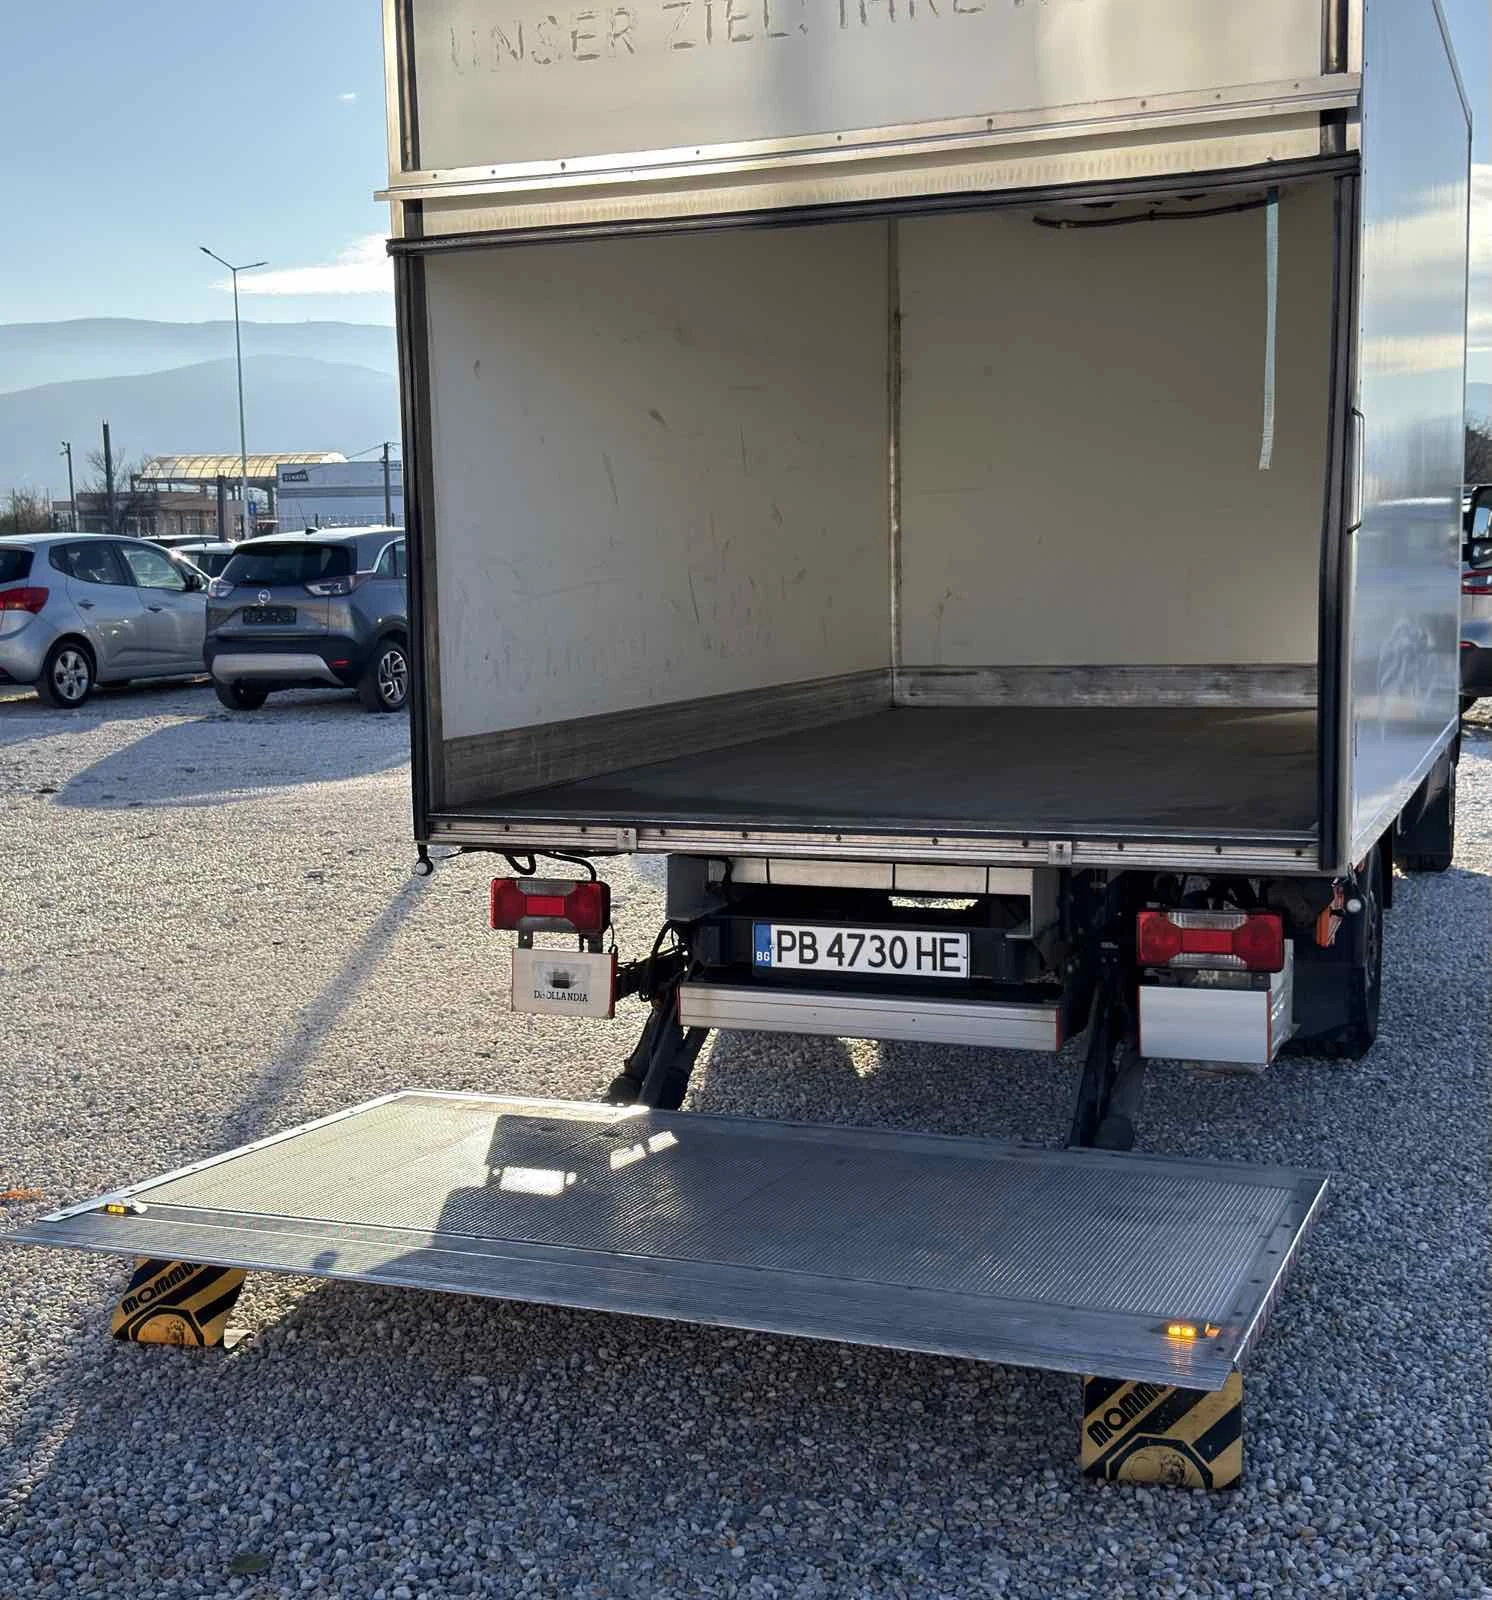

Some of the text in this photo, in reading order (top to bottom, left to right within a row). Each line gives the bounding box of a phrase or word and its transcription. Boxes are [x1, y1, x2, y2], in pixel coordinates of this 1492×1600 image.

[756, 951, 770, 962] BG
[776, 930, 961, 973] PB 4730 HE
